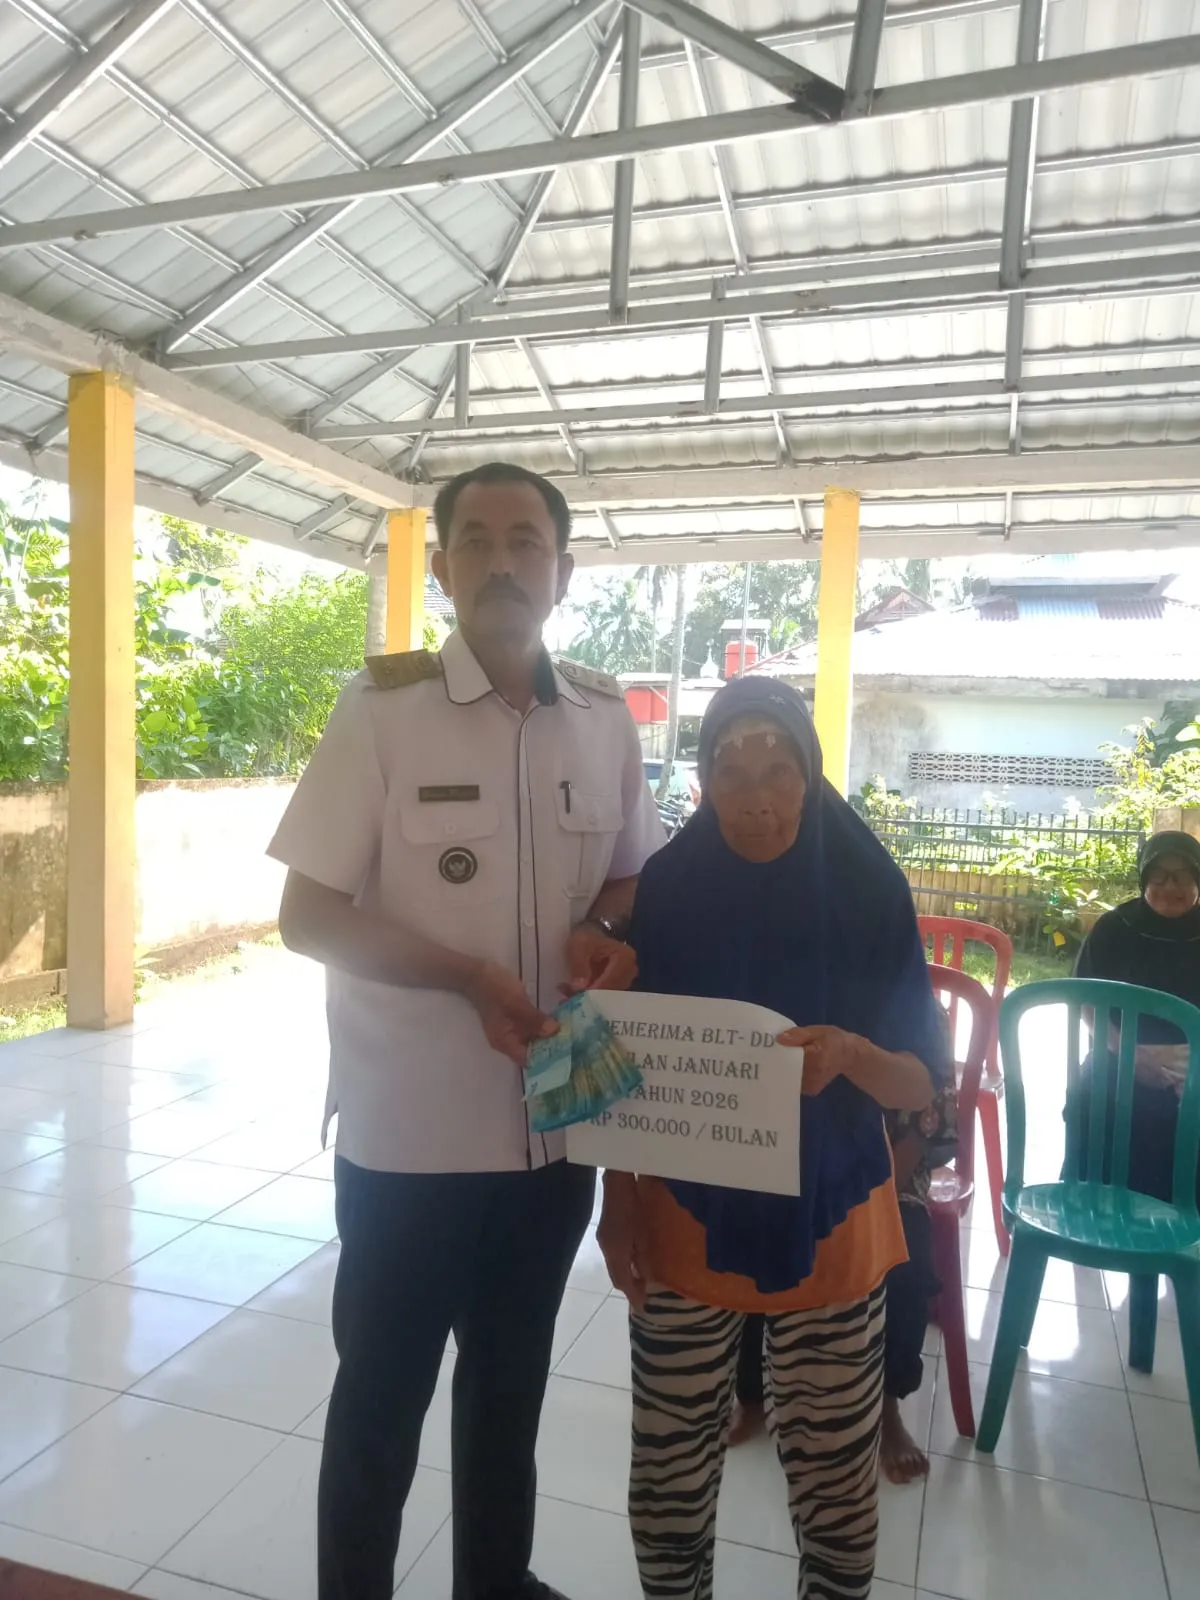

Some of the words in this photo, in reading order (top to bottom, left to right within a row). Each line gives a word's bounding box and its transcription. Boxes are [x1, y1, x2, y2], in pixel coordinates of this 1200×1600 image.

[750, 1030, 775, 1048] DD
[626, 1051, 667, 1070] LAN
[672, 1056, 759, 1080] JANUARI
[627, 1084, 685, 1104] AHUN
[691, 1089, 739, 1111] 2026
[617, 1112, 690, 1137] 300.000
[695, 1121, 707, 1141] /
[711, 1124, 778, 1148] BULAN
